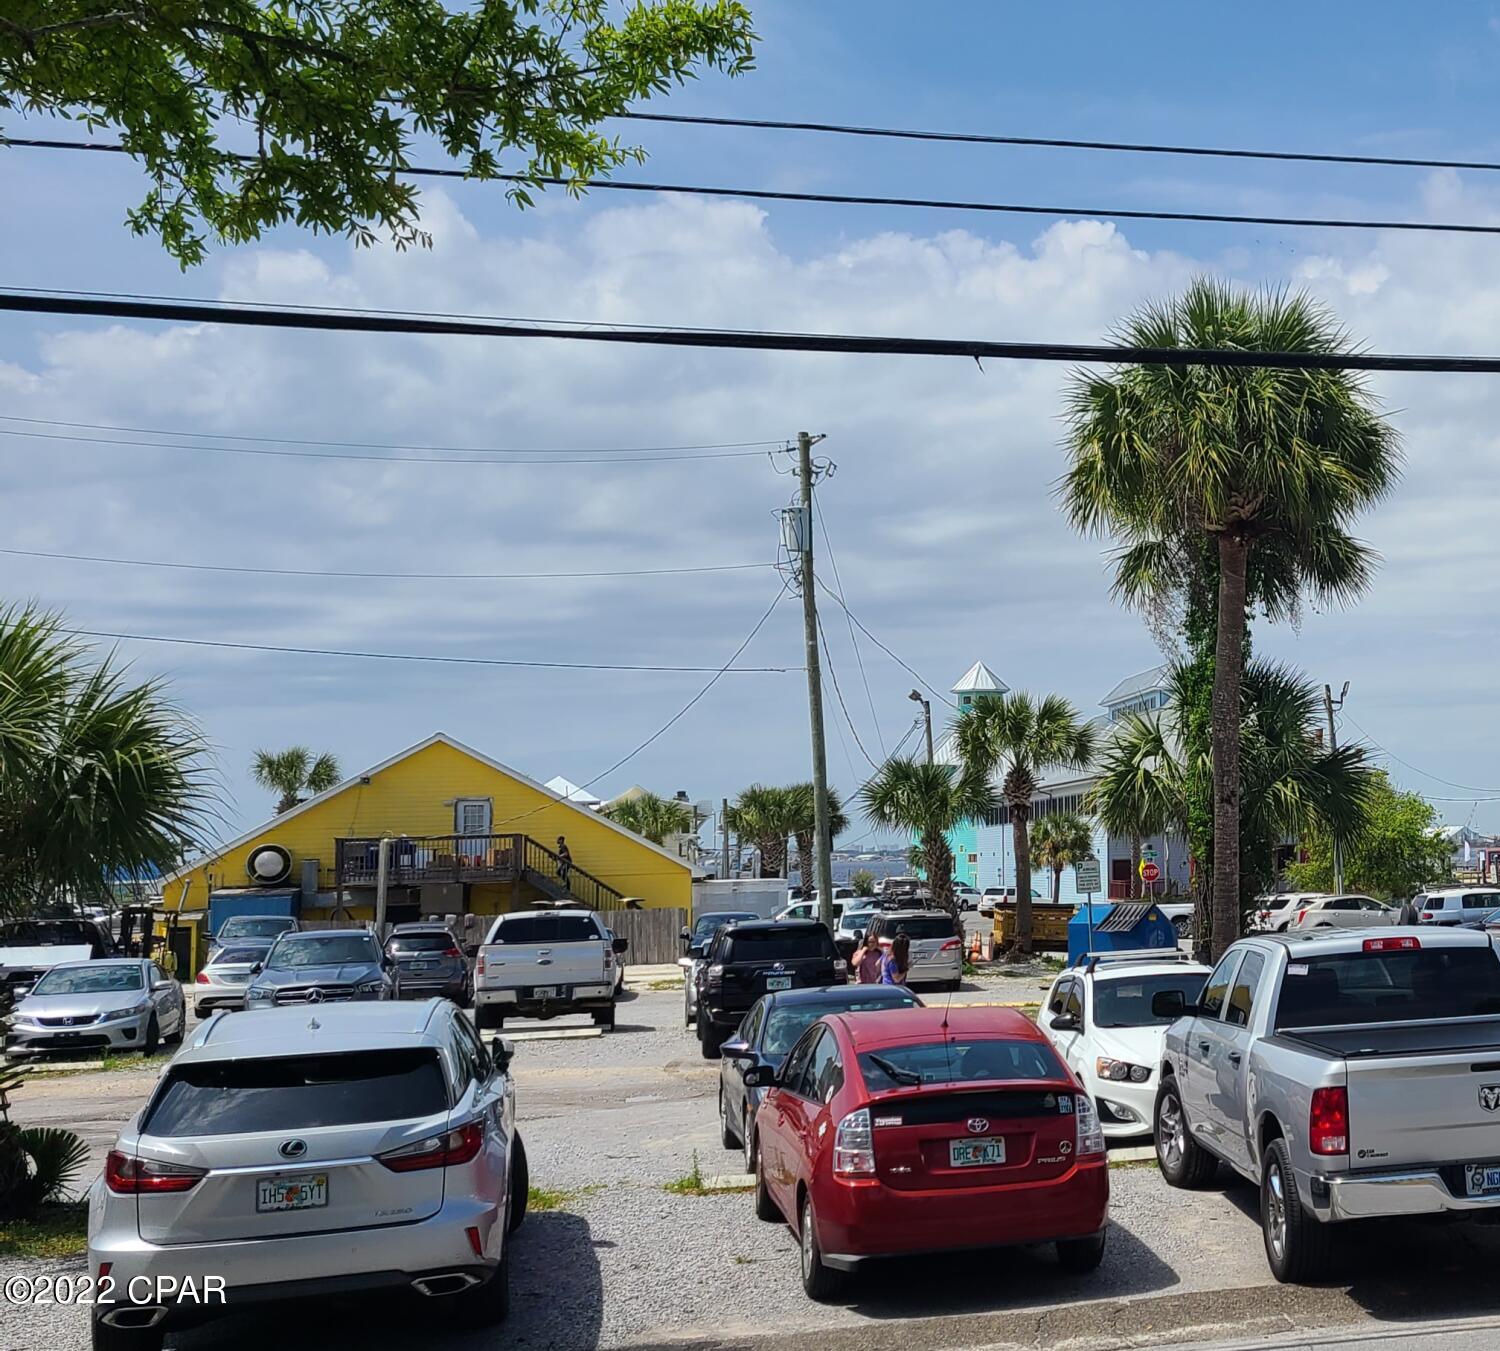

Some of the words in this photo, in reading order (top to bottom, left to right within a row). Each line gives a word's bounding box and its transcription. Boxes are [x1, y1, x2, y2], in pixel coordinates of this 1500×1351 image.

[1143, 868, 1159, 877] STOP
[983, 1144, 1002, 1159] K71
[1037, 1155, 1067, 1164] PRIUS
